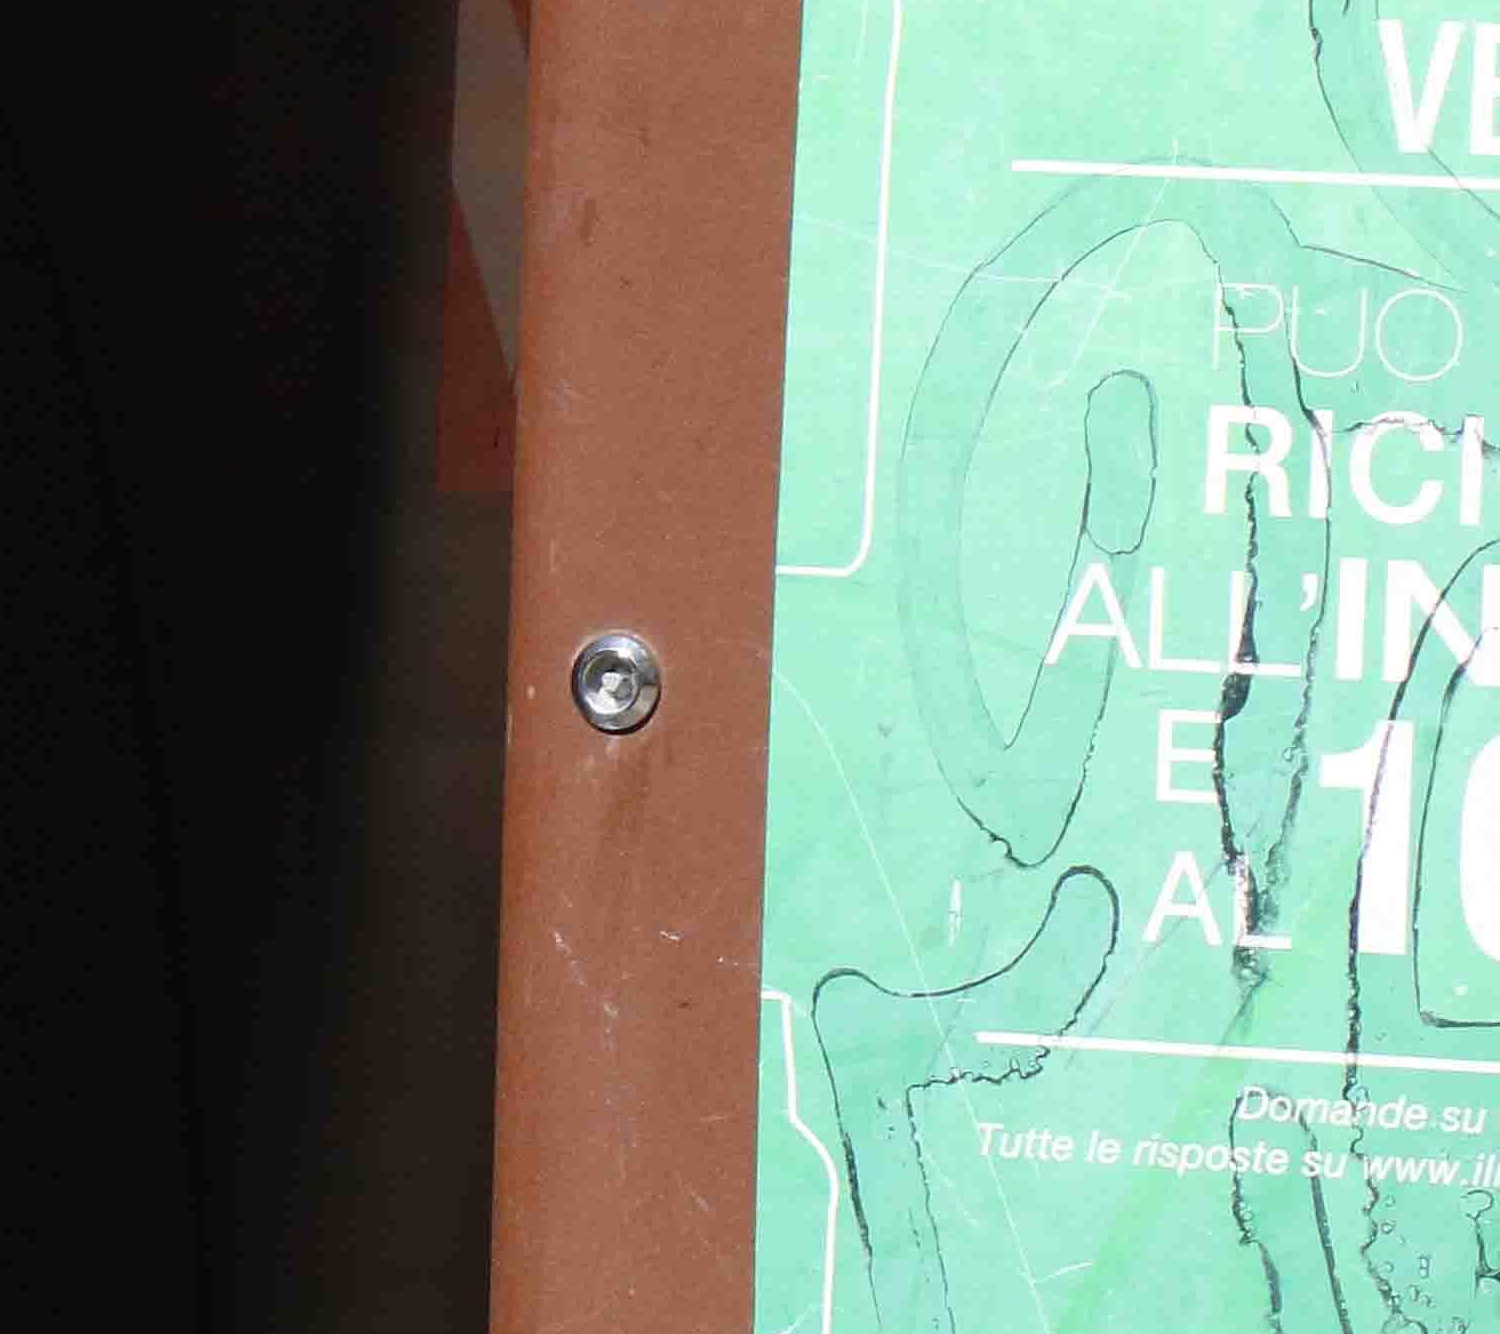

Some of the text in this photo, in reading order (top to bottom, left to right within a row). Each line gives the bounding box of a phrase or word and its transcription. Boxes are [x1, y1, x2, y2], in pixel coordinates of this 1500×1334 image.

[1155, 709, 1222, 803] E
[1142, 850, 1293, 950] AL
[1236, 1085, 1487, 1135] Domande su
[977, 1122, 1075, 1163] Tutte
[1087, 1129, 1121, 1163] le
[1134, 1137, 1290, 1178] risposte
[1302, 1147, 1348, 1179] su
